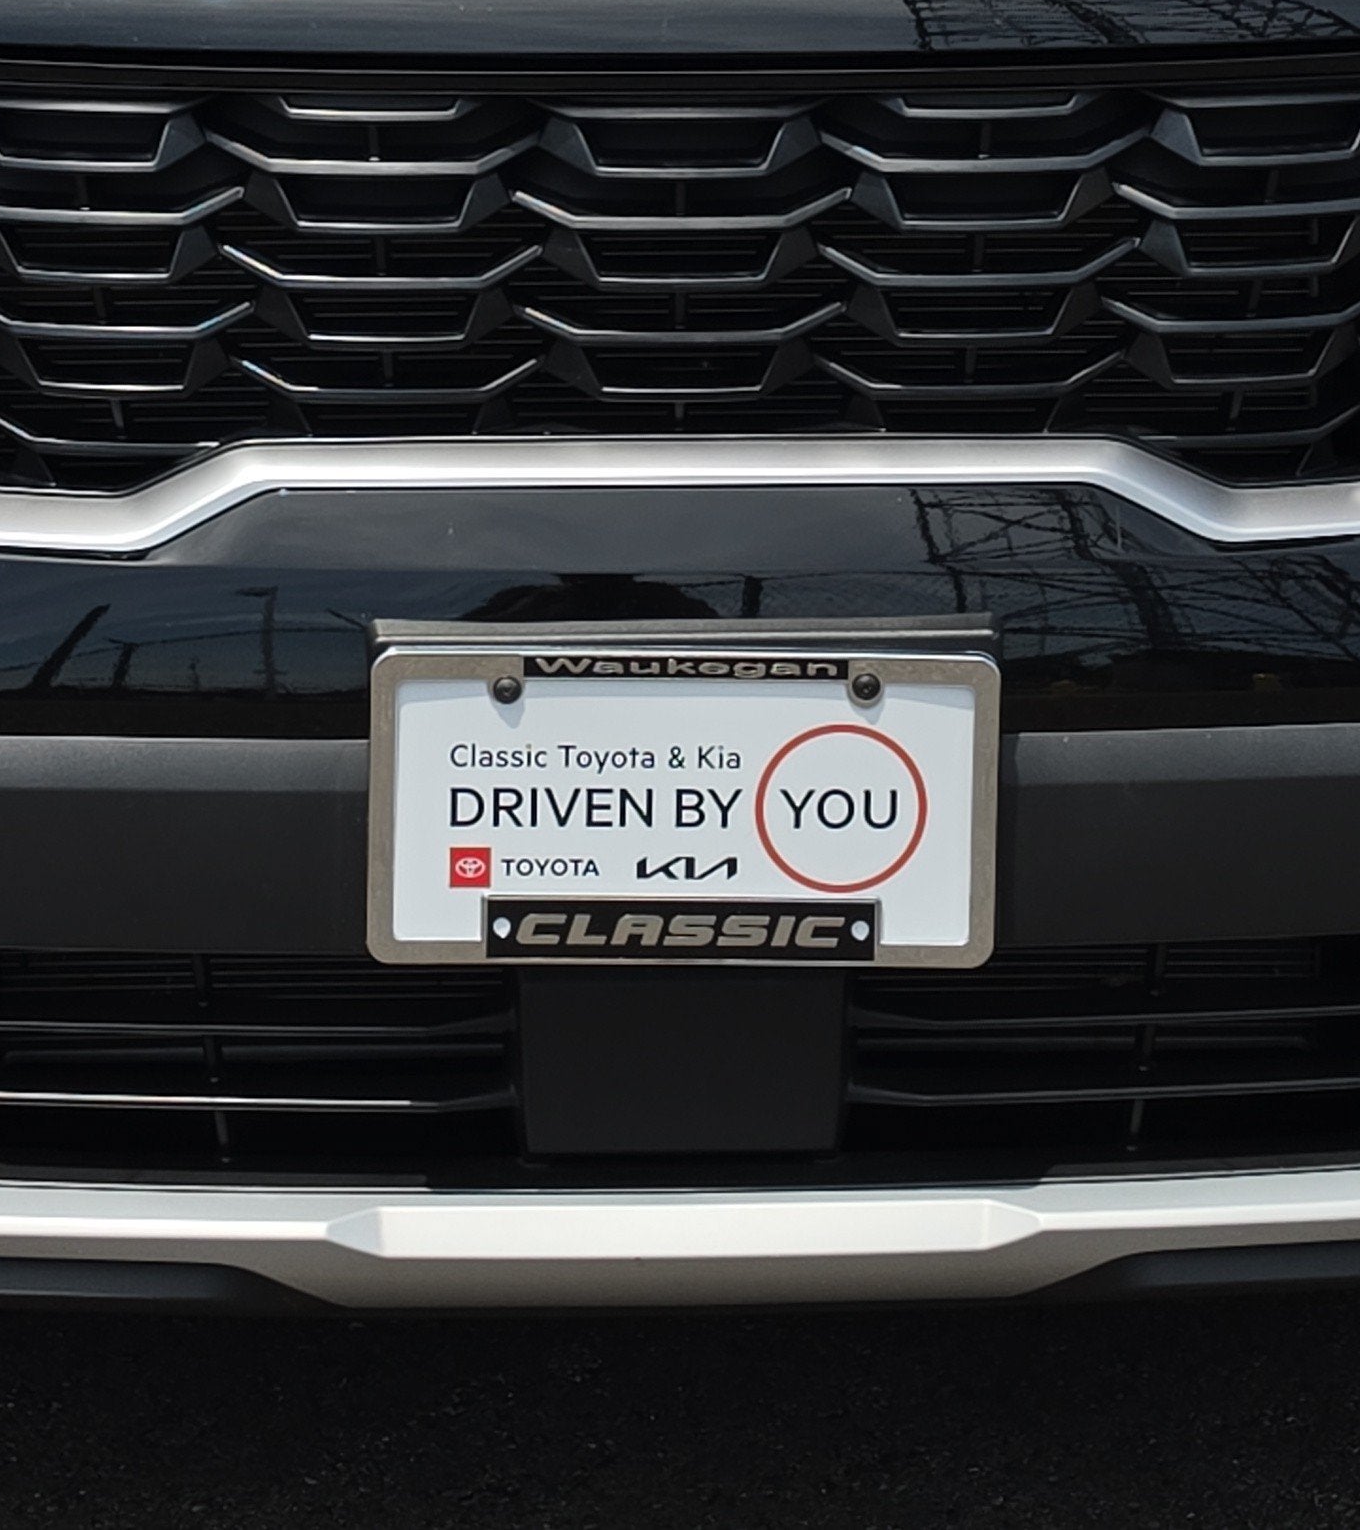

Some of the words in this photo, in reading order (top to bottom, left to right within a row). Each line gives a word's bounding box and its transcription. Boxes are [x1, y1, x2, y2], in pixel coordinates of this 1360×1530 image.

[449, 743, 548, 769] Classic
[557, 745, 655, 774] Toyota
[668, 745, 686, 769] &
[697, 745, 741, 770] Kia
[449, 787, 654, 828] DRIVEN
[674, 788, 743, 829] BY
[780, 788, 898, 830] YOU
[501, 858, 600, 877] TOYOTA
[636, 857, 738, 881] KIA
[515, 913, 846, 948] CLASSIC
